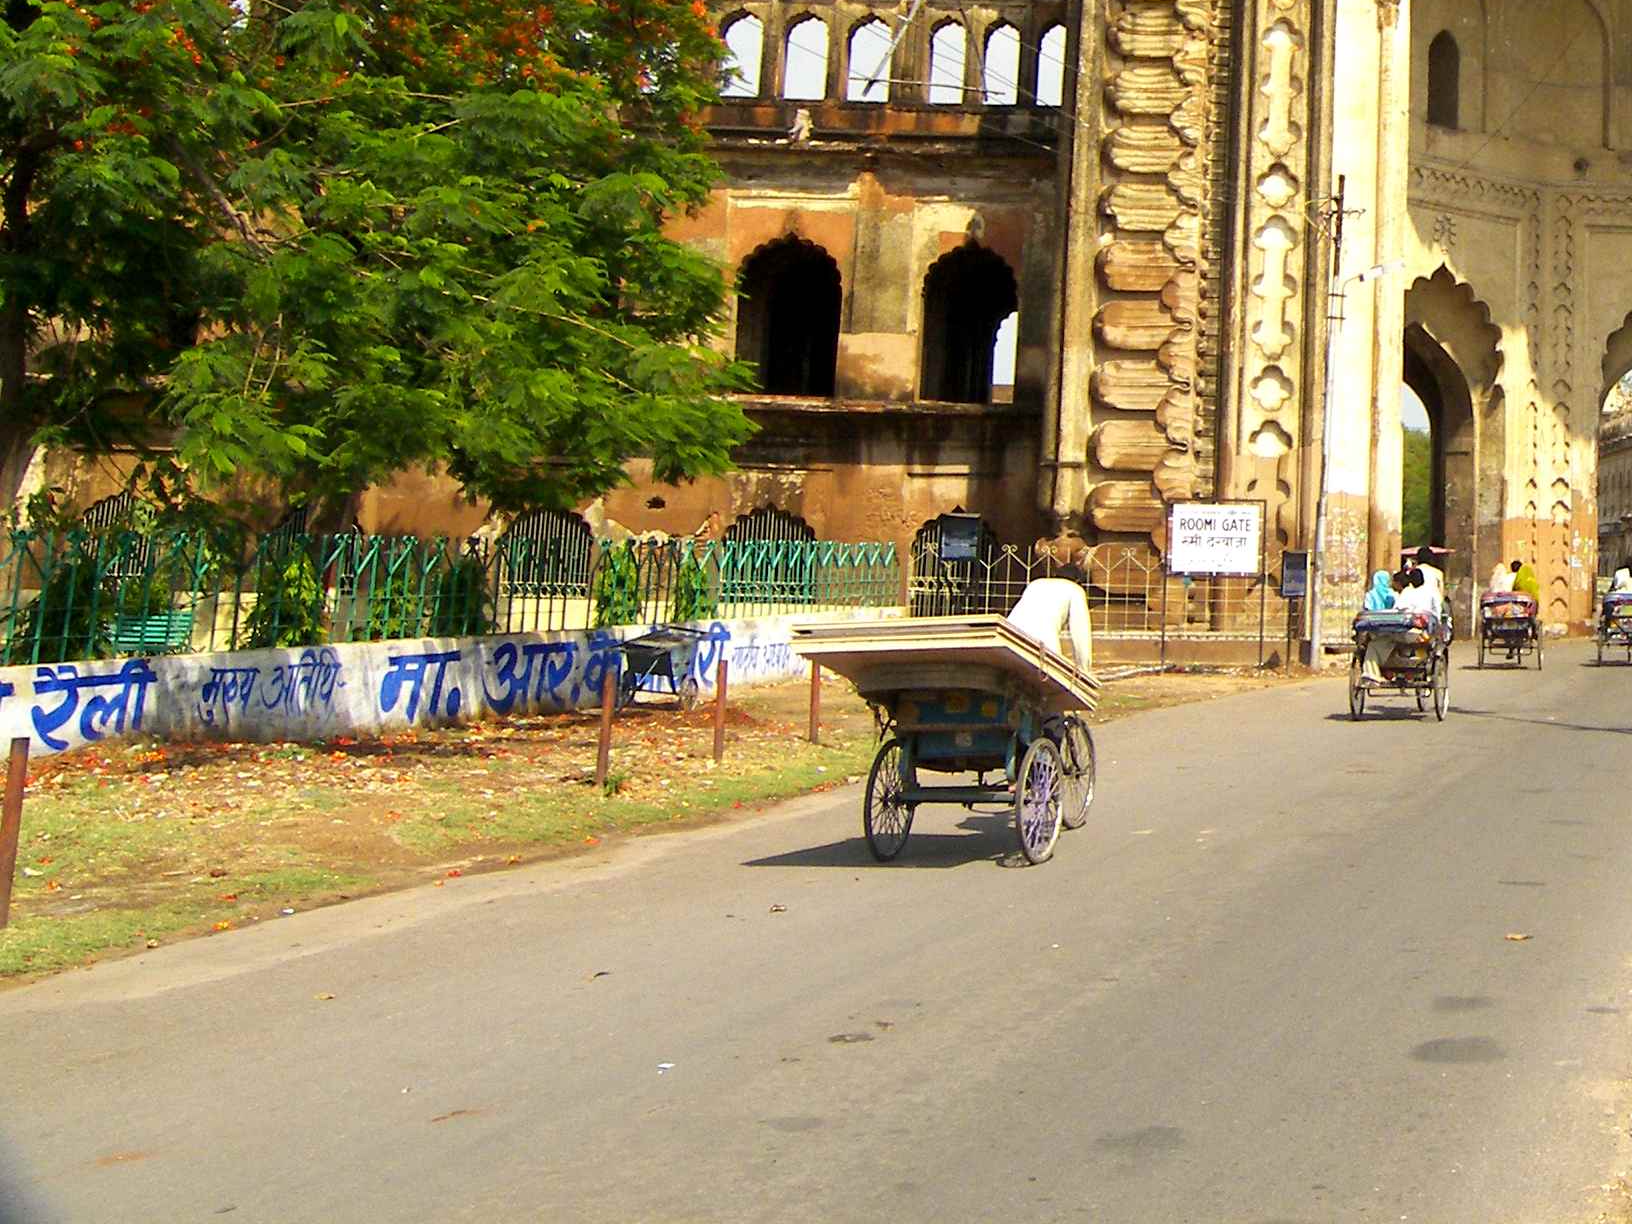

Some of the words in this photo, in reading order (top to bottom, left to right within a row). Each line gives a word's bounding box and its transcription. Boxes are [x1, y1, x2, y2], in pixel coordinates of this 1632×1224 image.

[1180, 518, 1216, 531] ROOMI
[1222, 519, 1251, 532] GATE
[31, 658, 157, 750] रैली
[197, 667, 260, 726] मुख्य
[380, 651, 462, 724] मा.
